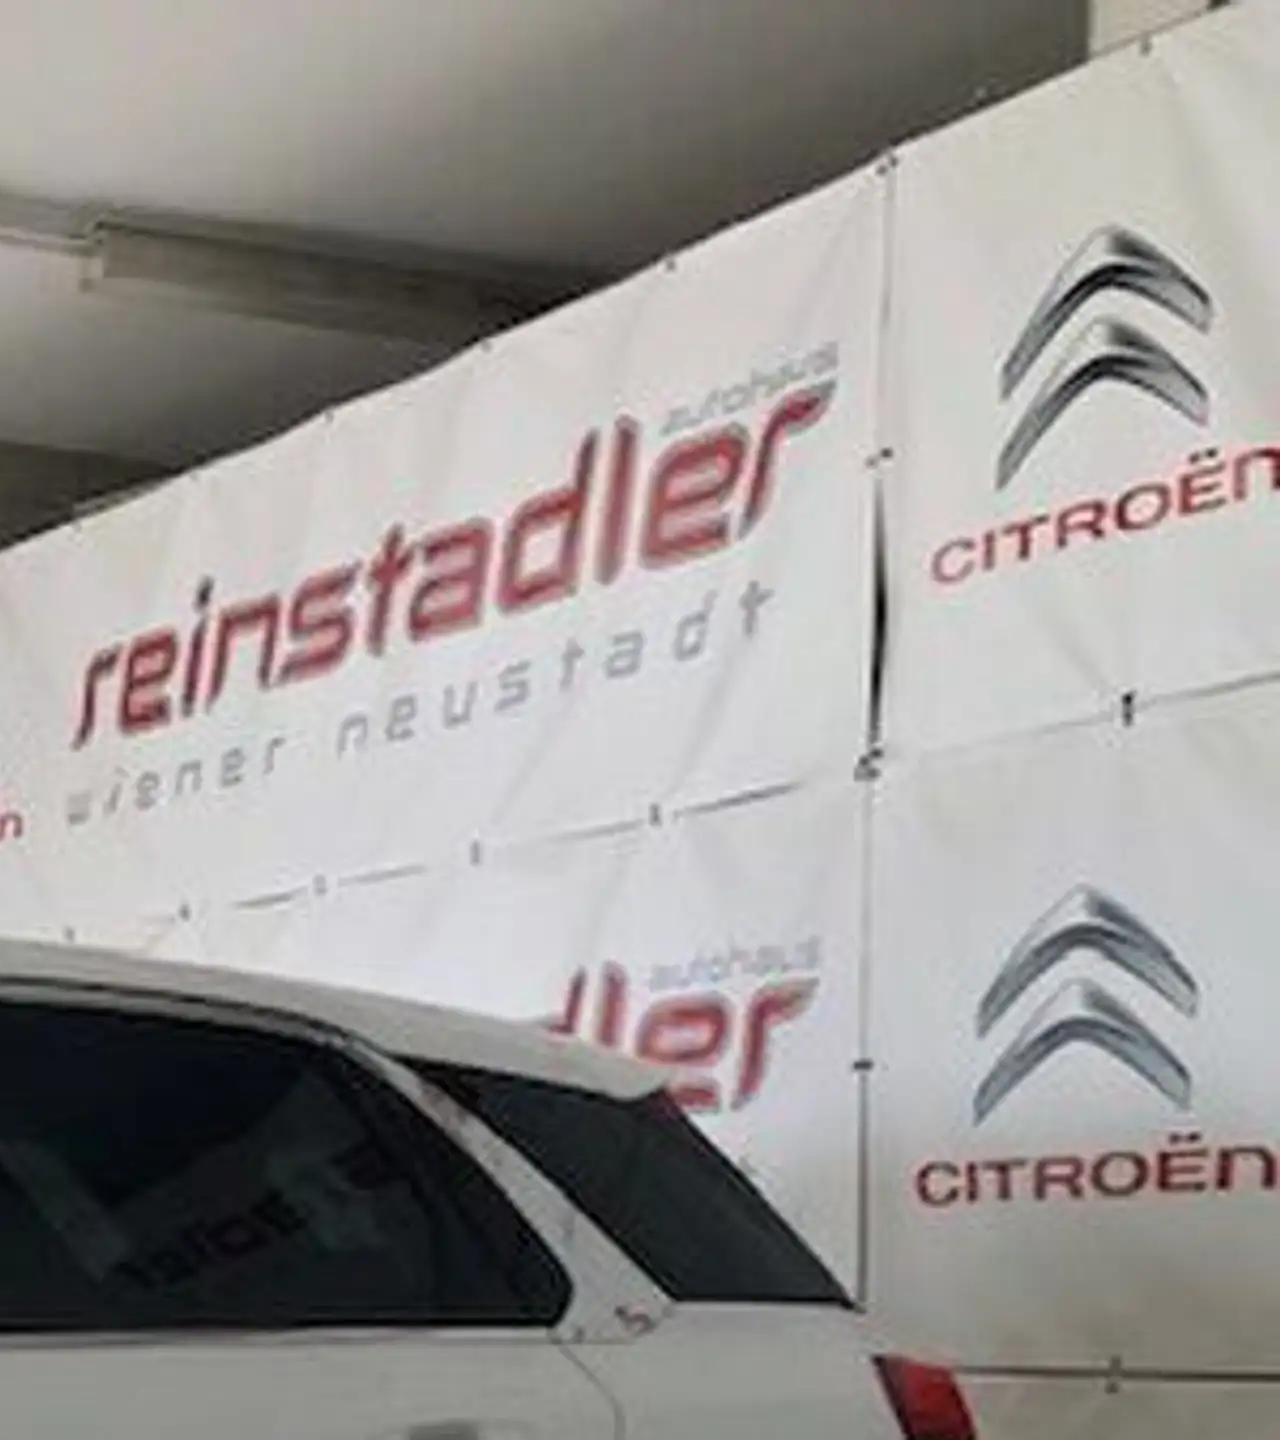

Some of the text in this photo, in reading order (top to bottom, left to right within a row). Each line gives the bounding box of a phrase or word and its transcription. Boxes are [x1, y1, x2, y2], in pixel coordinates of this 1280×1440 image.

[70, 377, 838, 752] reinstadler
[65, 578, 775, 827] wiener neustadt
[914, 1130, 1280, 1207] CITROËN
